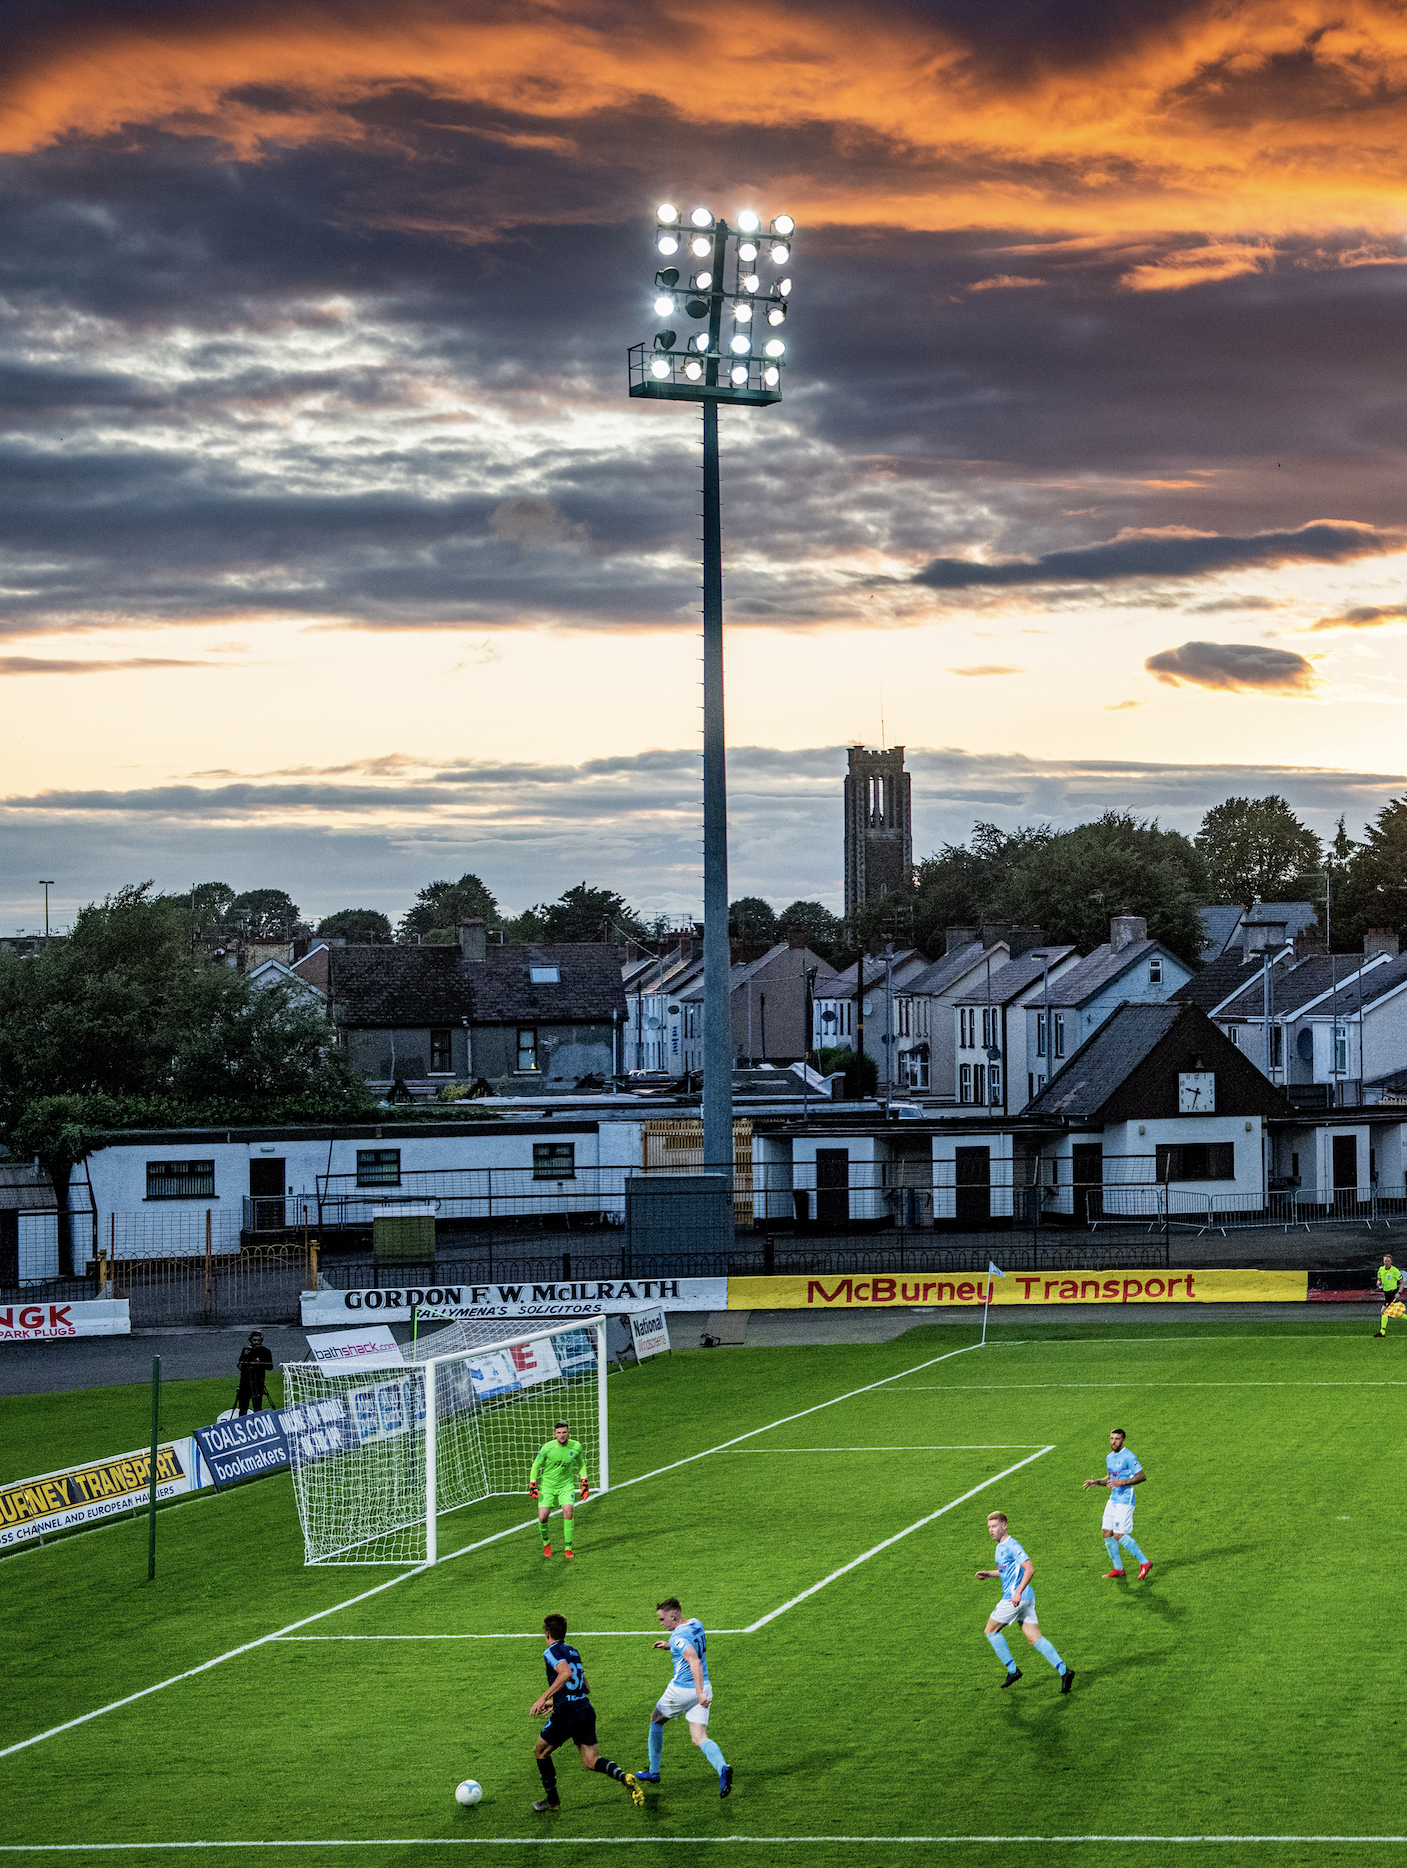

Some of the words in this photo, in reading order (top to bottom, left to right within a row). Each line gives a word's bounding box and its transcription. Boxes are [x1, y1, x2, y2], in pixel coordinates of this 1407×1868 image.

[344, 1288, 463, 1310] GORDON
[470, 1286, 490, 1304] F.
[498, 1285, 525, 1304] W.
[531, 1280, 681, 1303] McILRATH
[807, 1279, 994, 1305] McBurney
[1015, 1274, 1196, 1303] Transport
[411, 1306, 508, 1319] BALLYMENA'S
[518, 1304, 603, 1315] SOLICITORS
[633, 1312, 664, 1338] National
[34, 1327, 76, 1337] PLUGS
[314, 1341, 398, 1360] bathshack.com
[201, 1413, 277, 1453] TOALS.COM
[75, 1451, 179, 1500] TRANSPORT
[214, 1446, 288, 1481] bookmakers
[16, 1518, 62, 1539] CHANNEL
[65, 1511, 85, 1526] AND
[88, 1497, 134, 1519] EUROPEAN
[565, 1662, 585, 1690] 37
